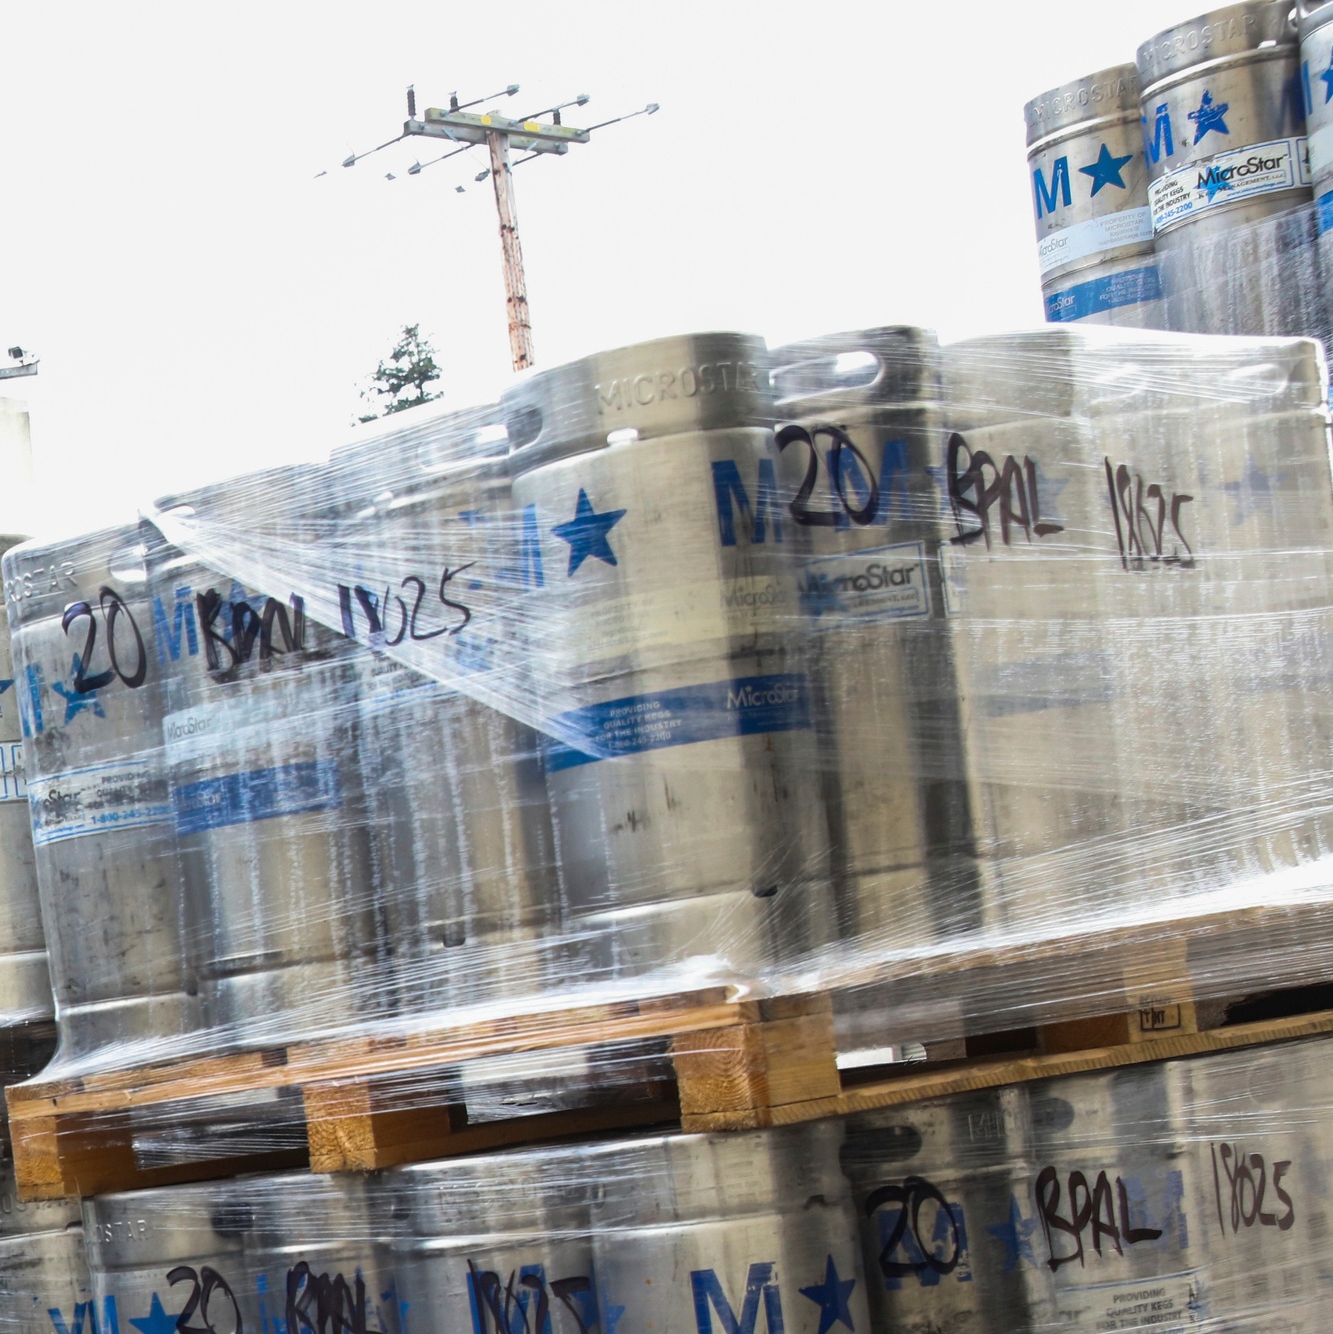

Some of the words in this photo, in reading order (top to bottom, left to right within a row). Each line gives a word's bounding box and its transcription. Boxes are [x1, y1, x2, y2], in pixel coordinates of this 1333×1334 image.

[1033, 156, 1072, 220] M
[1197, 156, 1284, 190] MicroStar
[711, 459, 783, 547] M
[775, 425, 879, 528] 20
[61, 585, 147, 694] 20
[1035, 1165, 1163, 1272] BPAL
